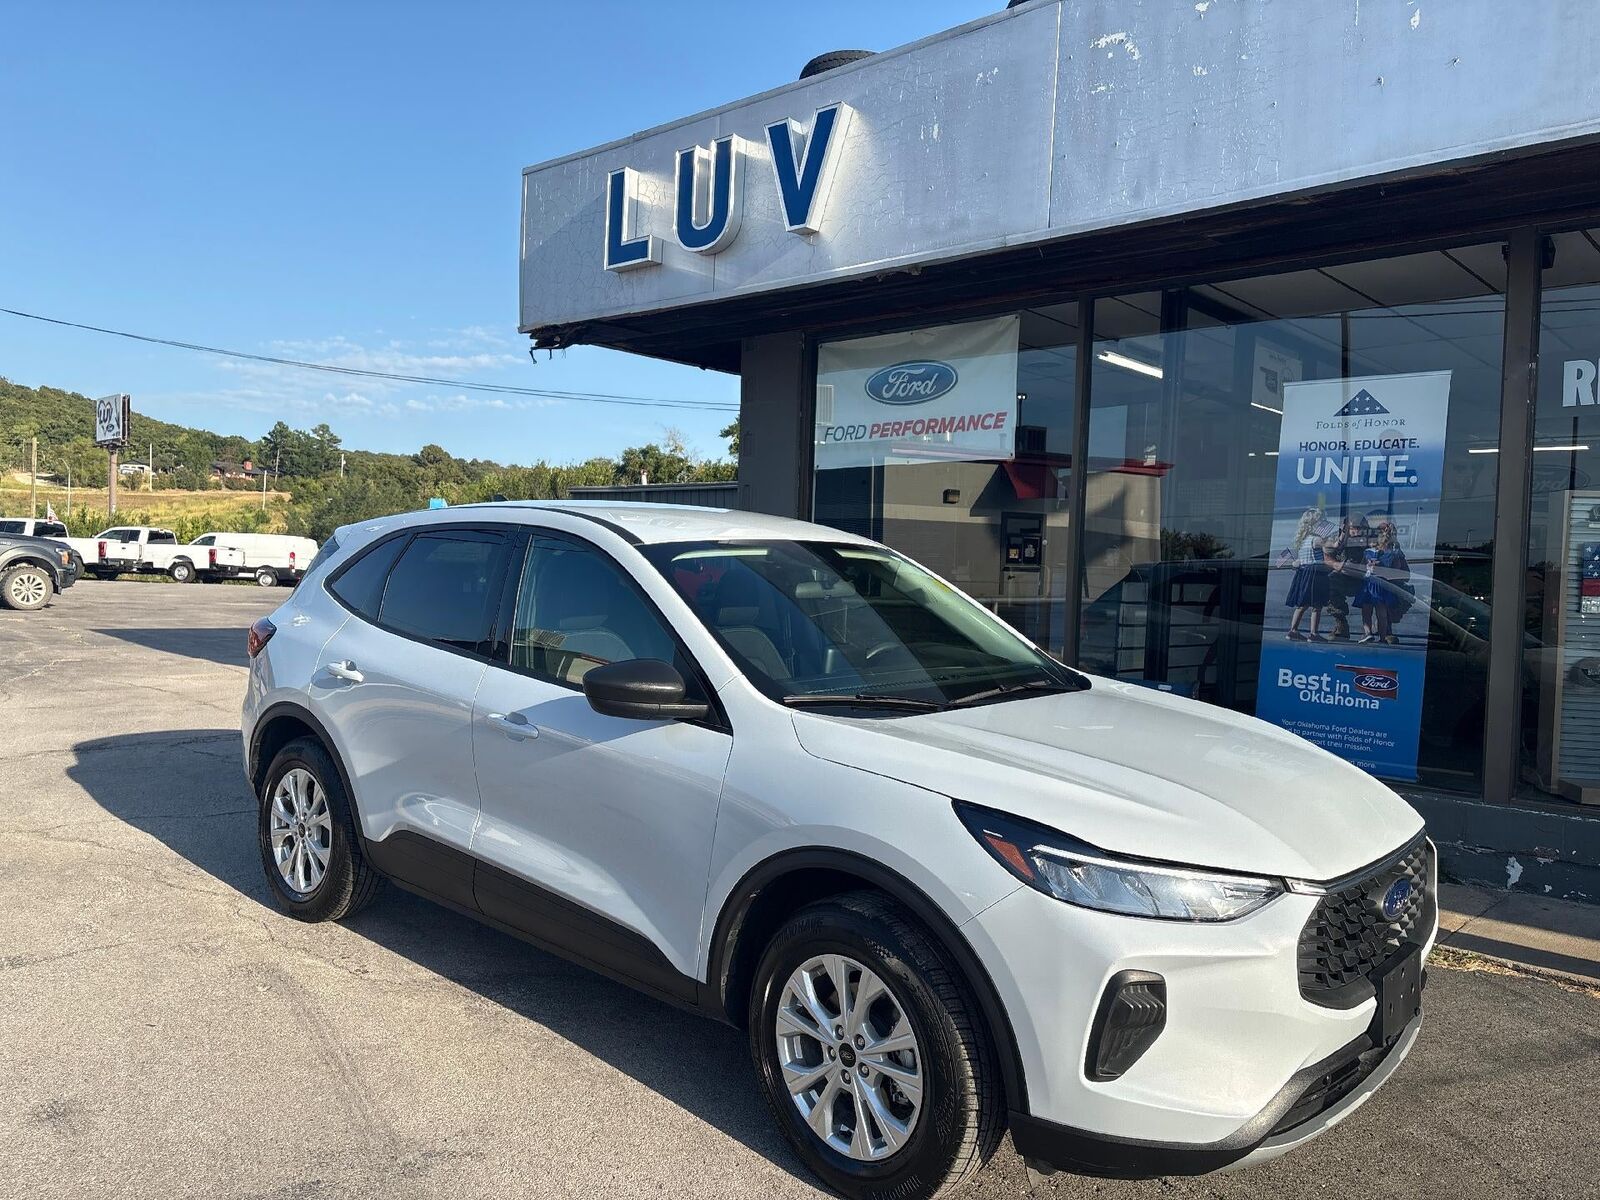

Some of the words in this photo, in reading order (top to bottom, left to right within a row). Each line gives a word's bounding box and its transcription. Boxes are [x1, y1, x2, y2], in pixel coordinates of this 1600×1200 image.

[604, 101, 852, 272] LUV
[882, 367, 939, 399] Ford
[1562, 358, 1600, 407] R
[824, 424, 867, 442] FORD
[868, 411, 1008, 440] PERFORMANCE
[1352, 419, 1362, 430] of
[1299, 440, 1350, 452] HONOR.
[1354, 437, 1420, 451] EDUCATE.
[1296, 454, 1418, 485] UNITE.
[1277, 668, 1331, 692] Best
[1335, 680, 1350, 693] in
[1361, 675, 1392, 690] Ford
[1299, 689, 1380, 710] Oklahoma
[1281, 718, 1296, 726] Your
[1297, 720, 1330, 731] Oklahoma
[1331, 724, 1347, 733] Ford
[1348, 727, 1374, 737] Dealers
[1375, 731, 1388, 739] are
[1302, 730, 1326, 738] partner
[1327, 732, 1342, 740] with
[1344, 734, 1363, 743] Folds
[1364, 736, 1372, 744] of
[1373, 738, 1395, 747] Honor
[1327, 740, 1343, 748] their
[1344, 743, 1373, 752] mission.
[1356, 760, 1377, 769] more.
